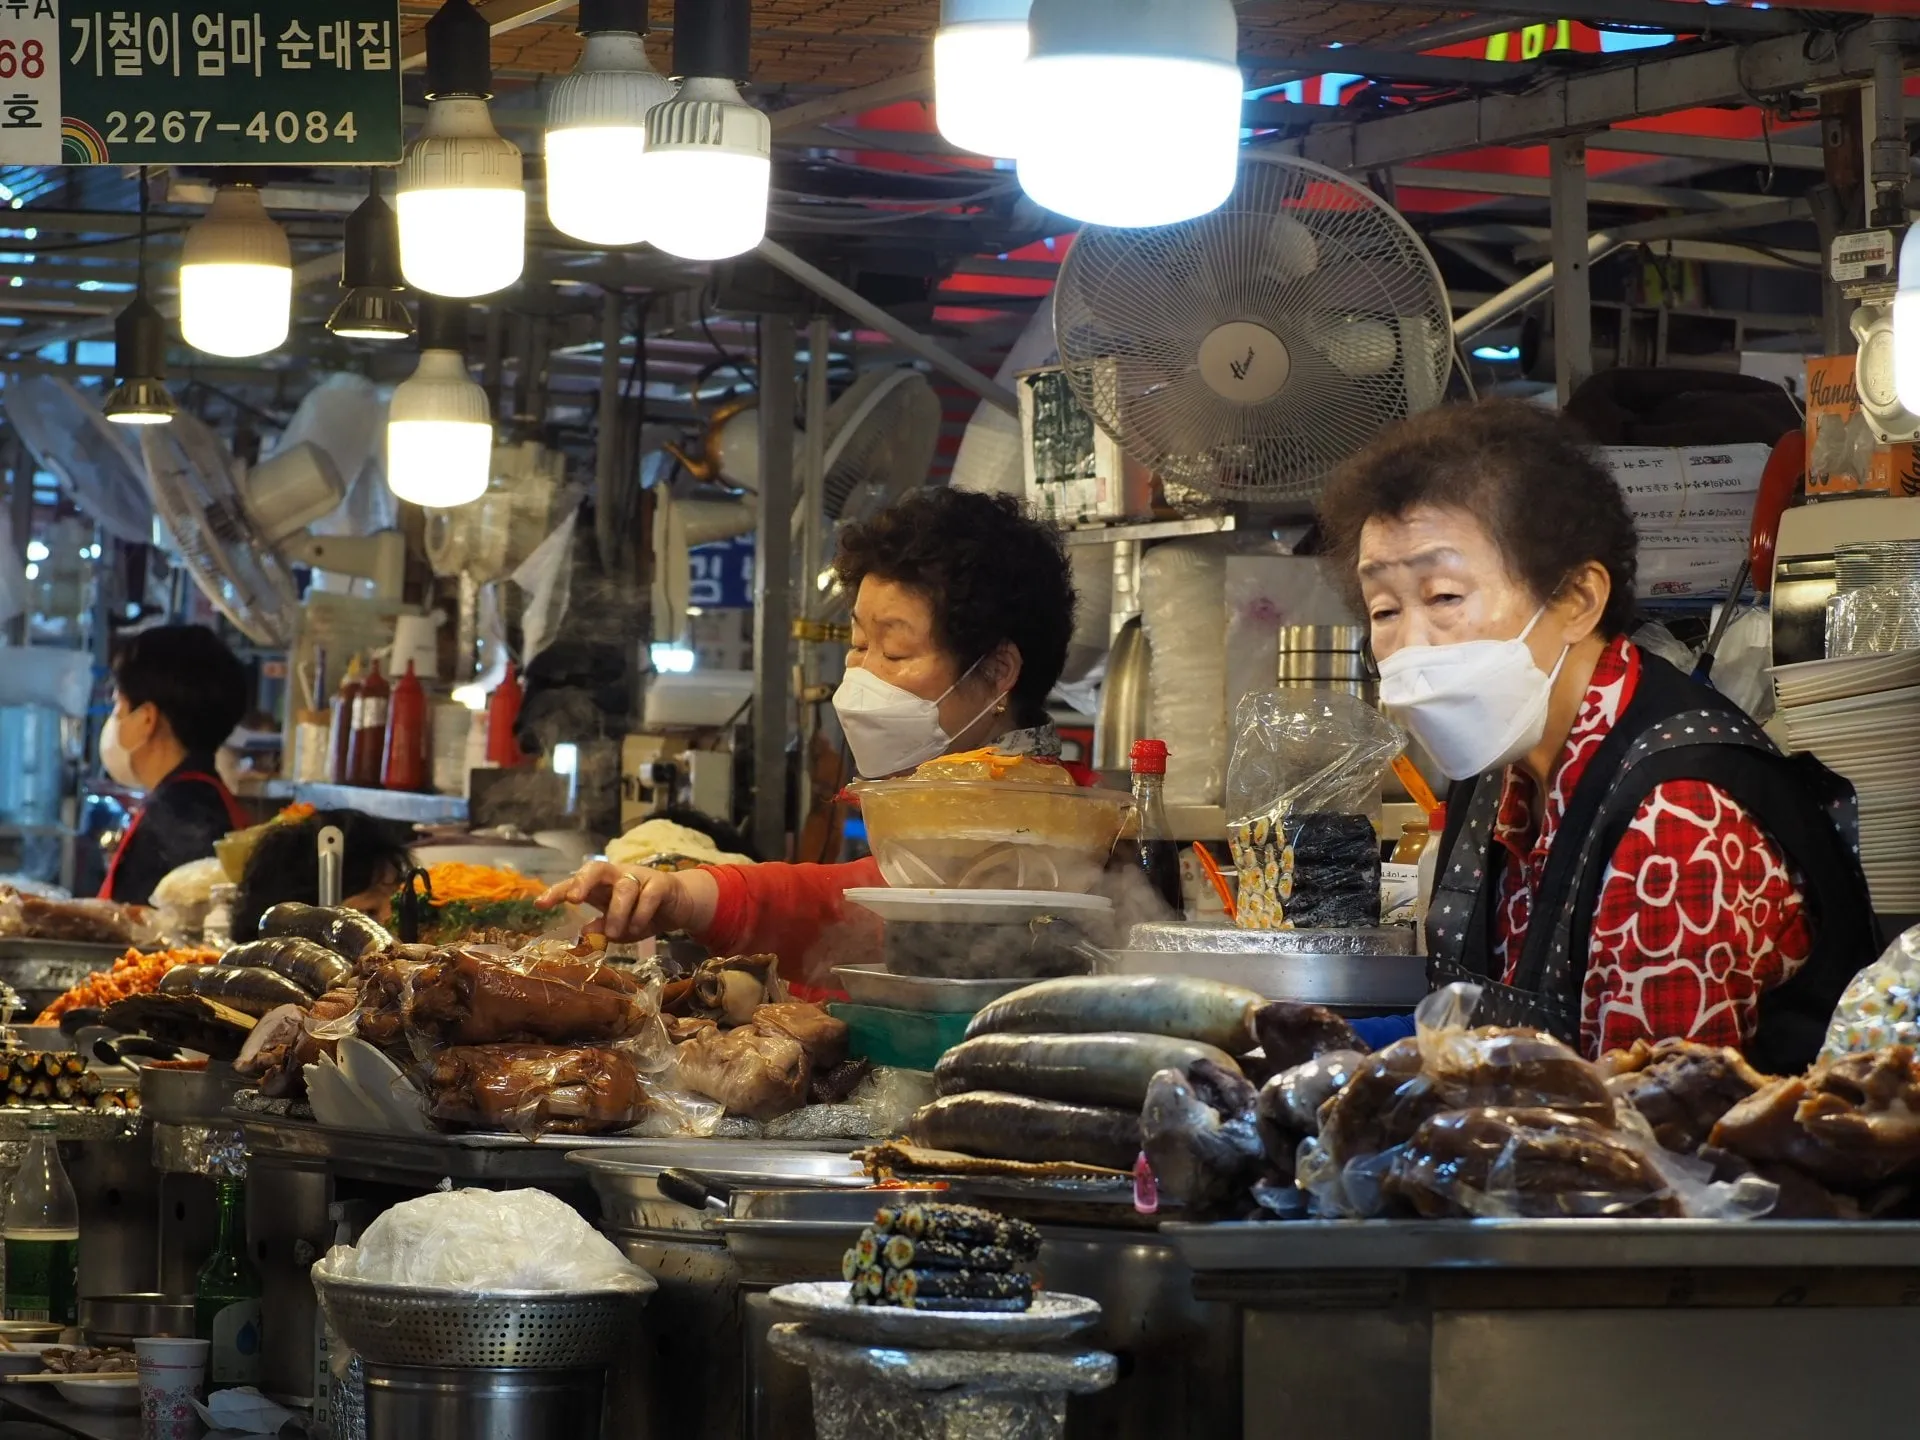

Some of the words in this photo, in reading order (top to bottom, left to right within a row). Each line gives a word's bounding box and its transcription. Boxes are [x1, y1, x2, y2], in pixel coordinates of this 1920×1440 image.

[70, 12, 179, 76] 기철이
[192, 12, 265, 76] 엄마
[277, 20, 391, 71] 순대집
[2, 94, 42, 128] 호
[105, 110, 358, 144] 2267-4084
